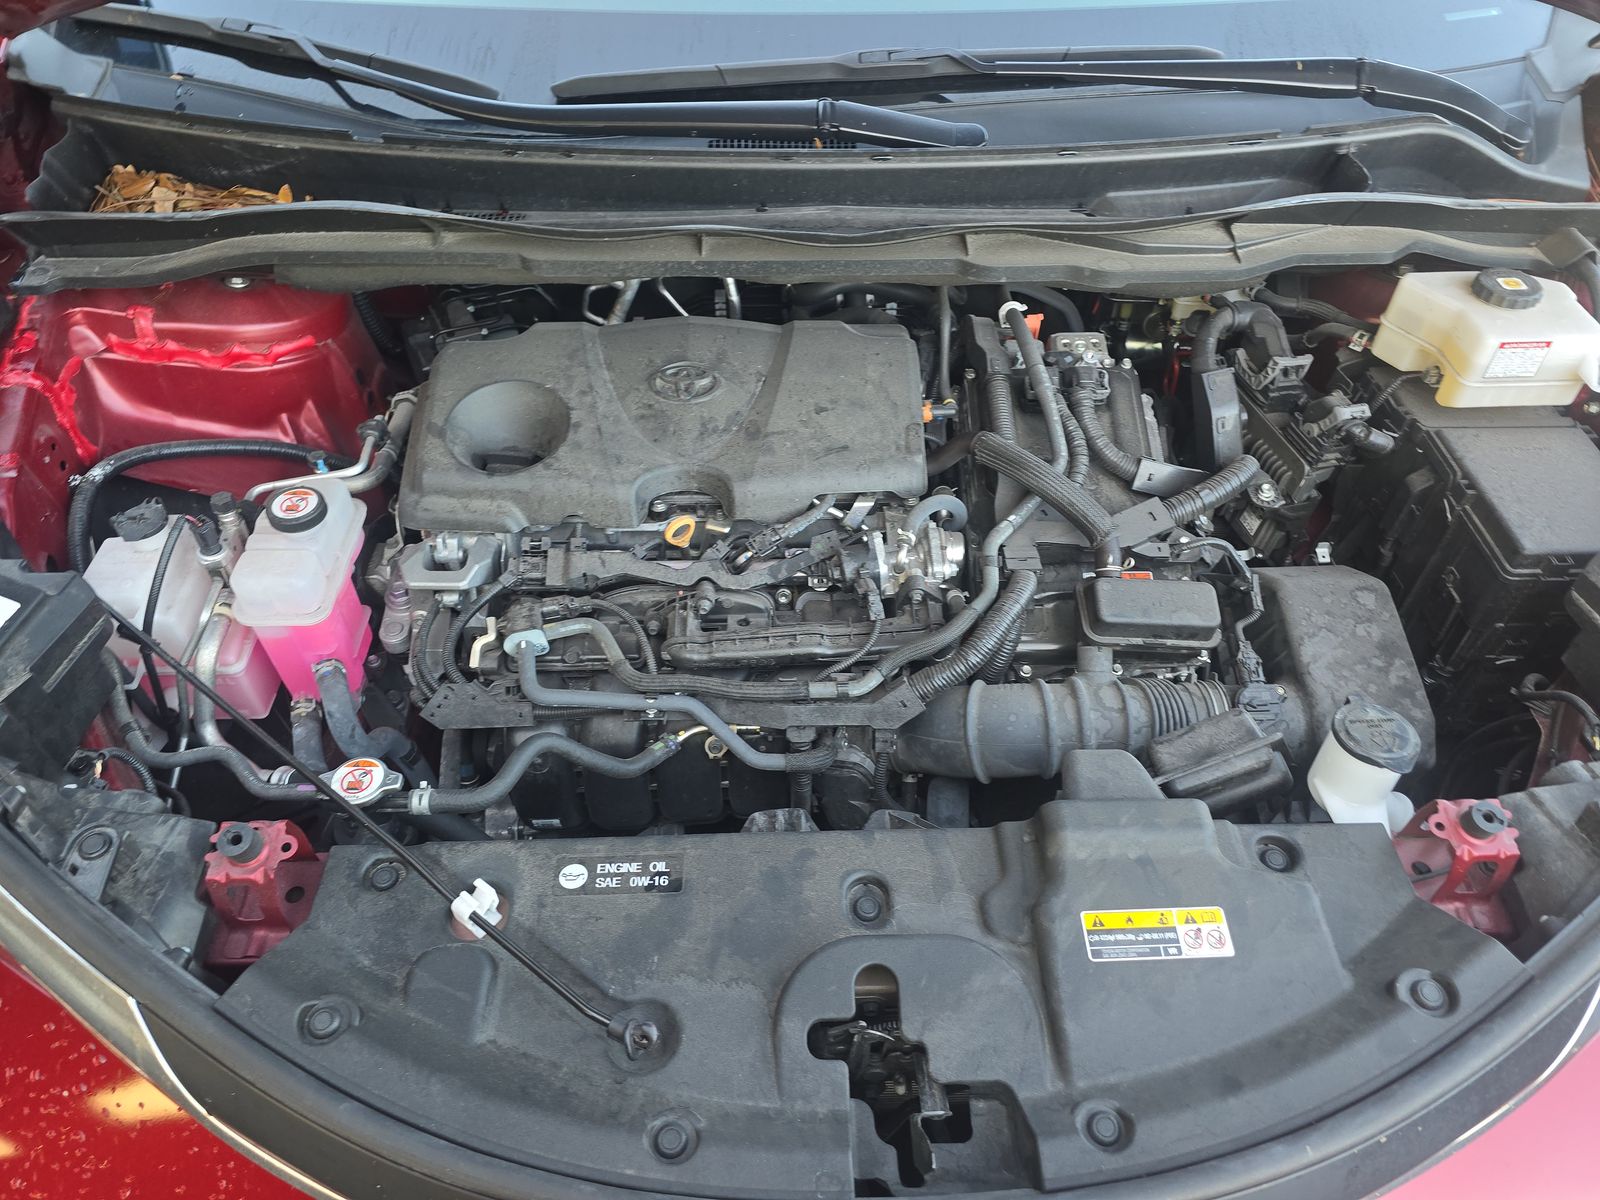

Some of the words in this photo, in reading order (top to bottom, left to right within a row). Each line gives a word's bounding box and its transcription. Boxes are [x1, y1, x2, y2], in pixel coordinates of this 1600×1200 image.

[596, 862, 643, 874] ENGINE
[649, 861, 670, 872] OIL
[595, 877, 621, 888] SAE
[629, 875, 669, 887] 0W-16
